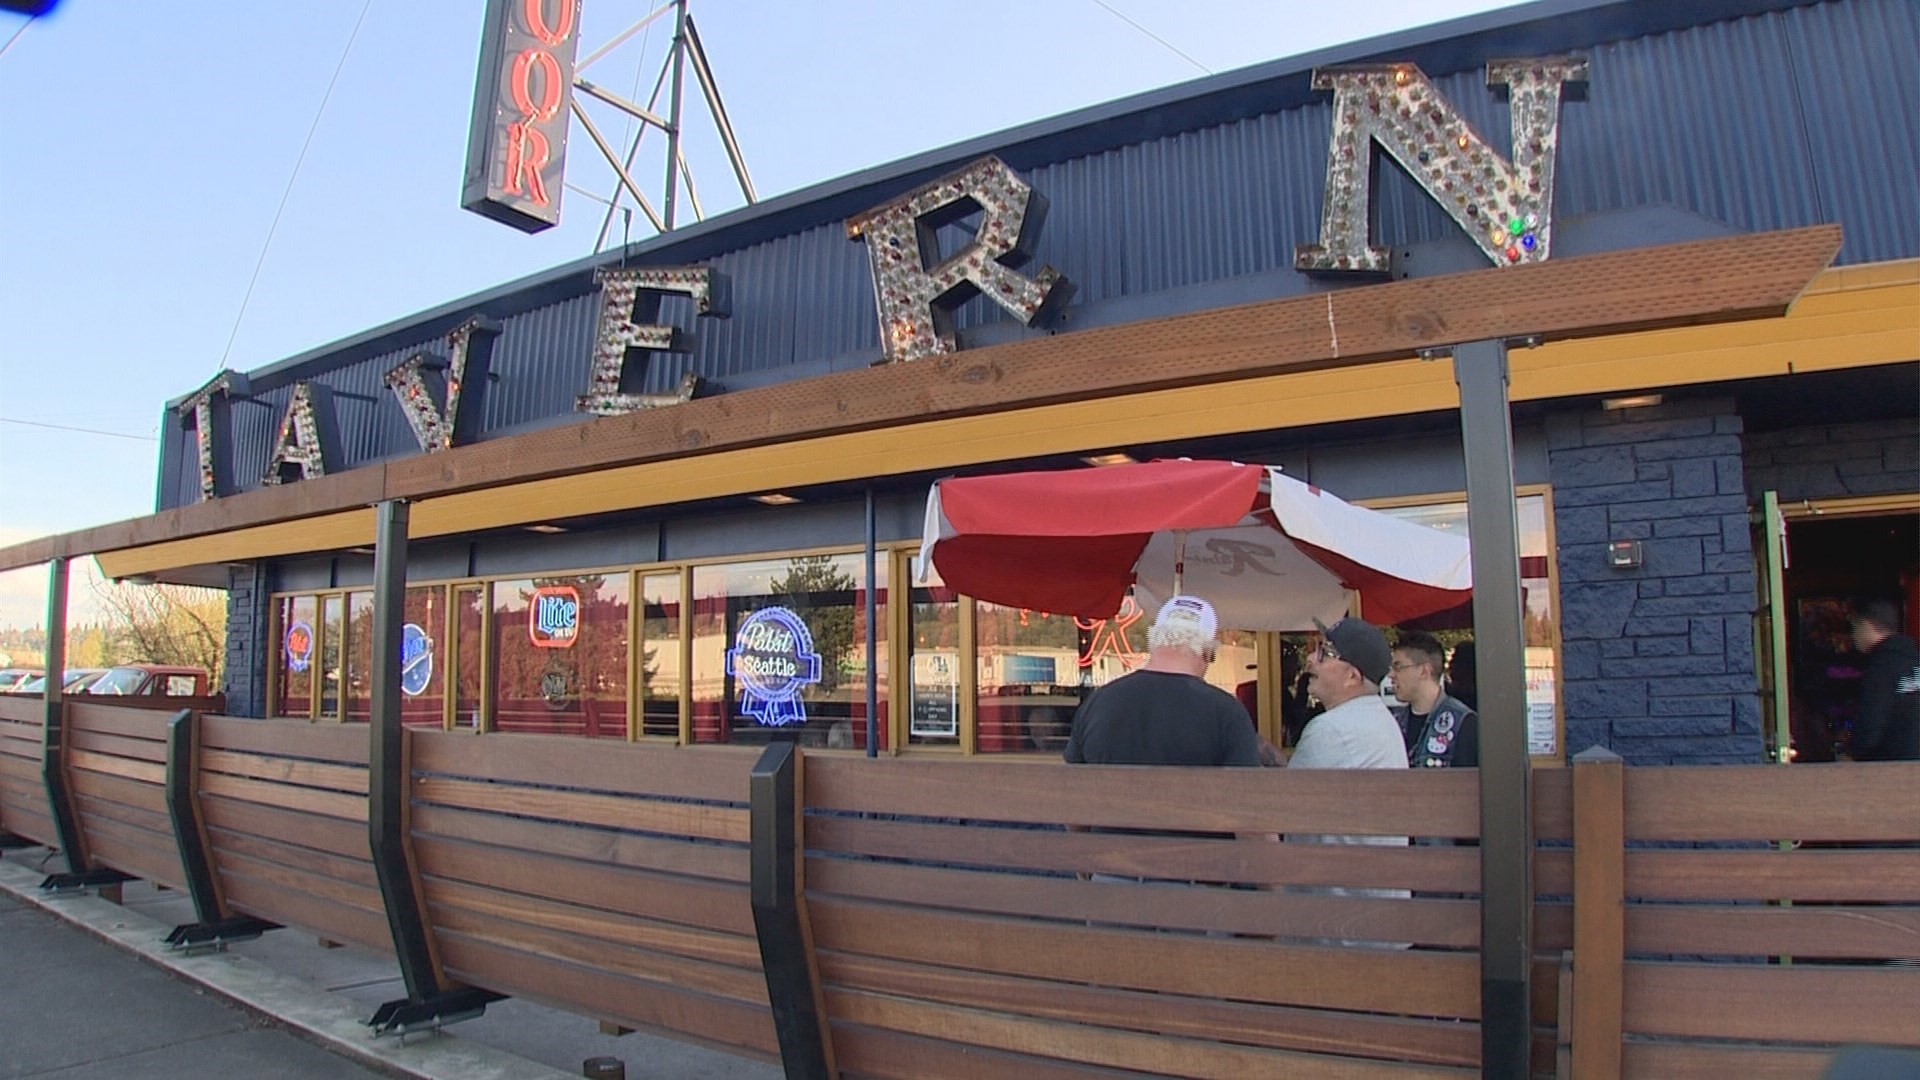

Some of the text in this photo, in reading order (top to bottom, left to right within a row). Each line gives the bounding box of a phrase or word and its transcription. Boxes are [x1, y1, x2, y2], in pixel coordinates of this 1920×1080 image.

[179, 57, 1589, 503] TAVERN
[538, 596, 576, 634] Lite
[743, 621, 793, 653] Pabst
[743, 655, 796, 677] Seattle
